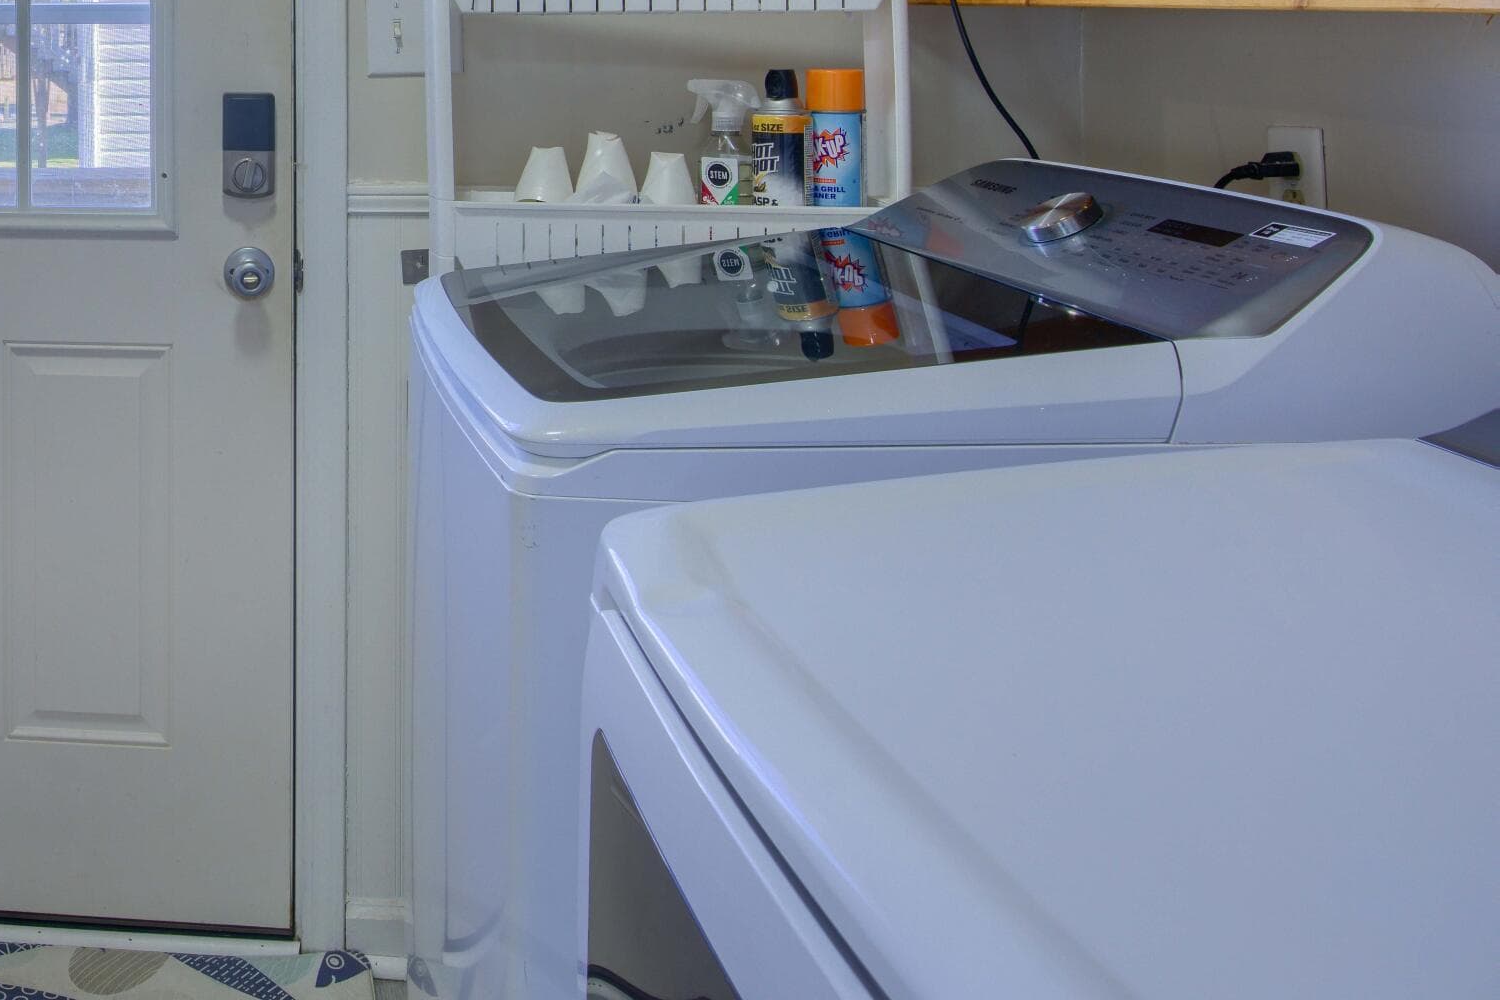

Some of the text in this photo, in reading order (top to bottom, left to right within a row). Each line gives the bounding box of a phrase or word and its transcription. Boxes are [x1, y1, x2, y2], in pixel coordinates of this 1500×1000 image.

[761, 123, 784, 132] SIZE
[709, 170, 728, 180] STEM
[820, 185, 846, 193] GRILL
